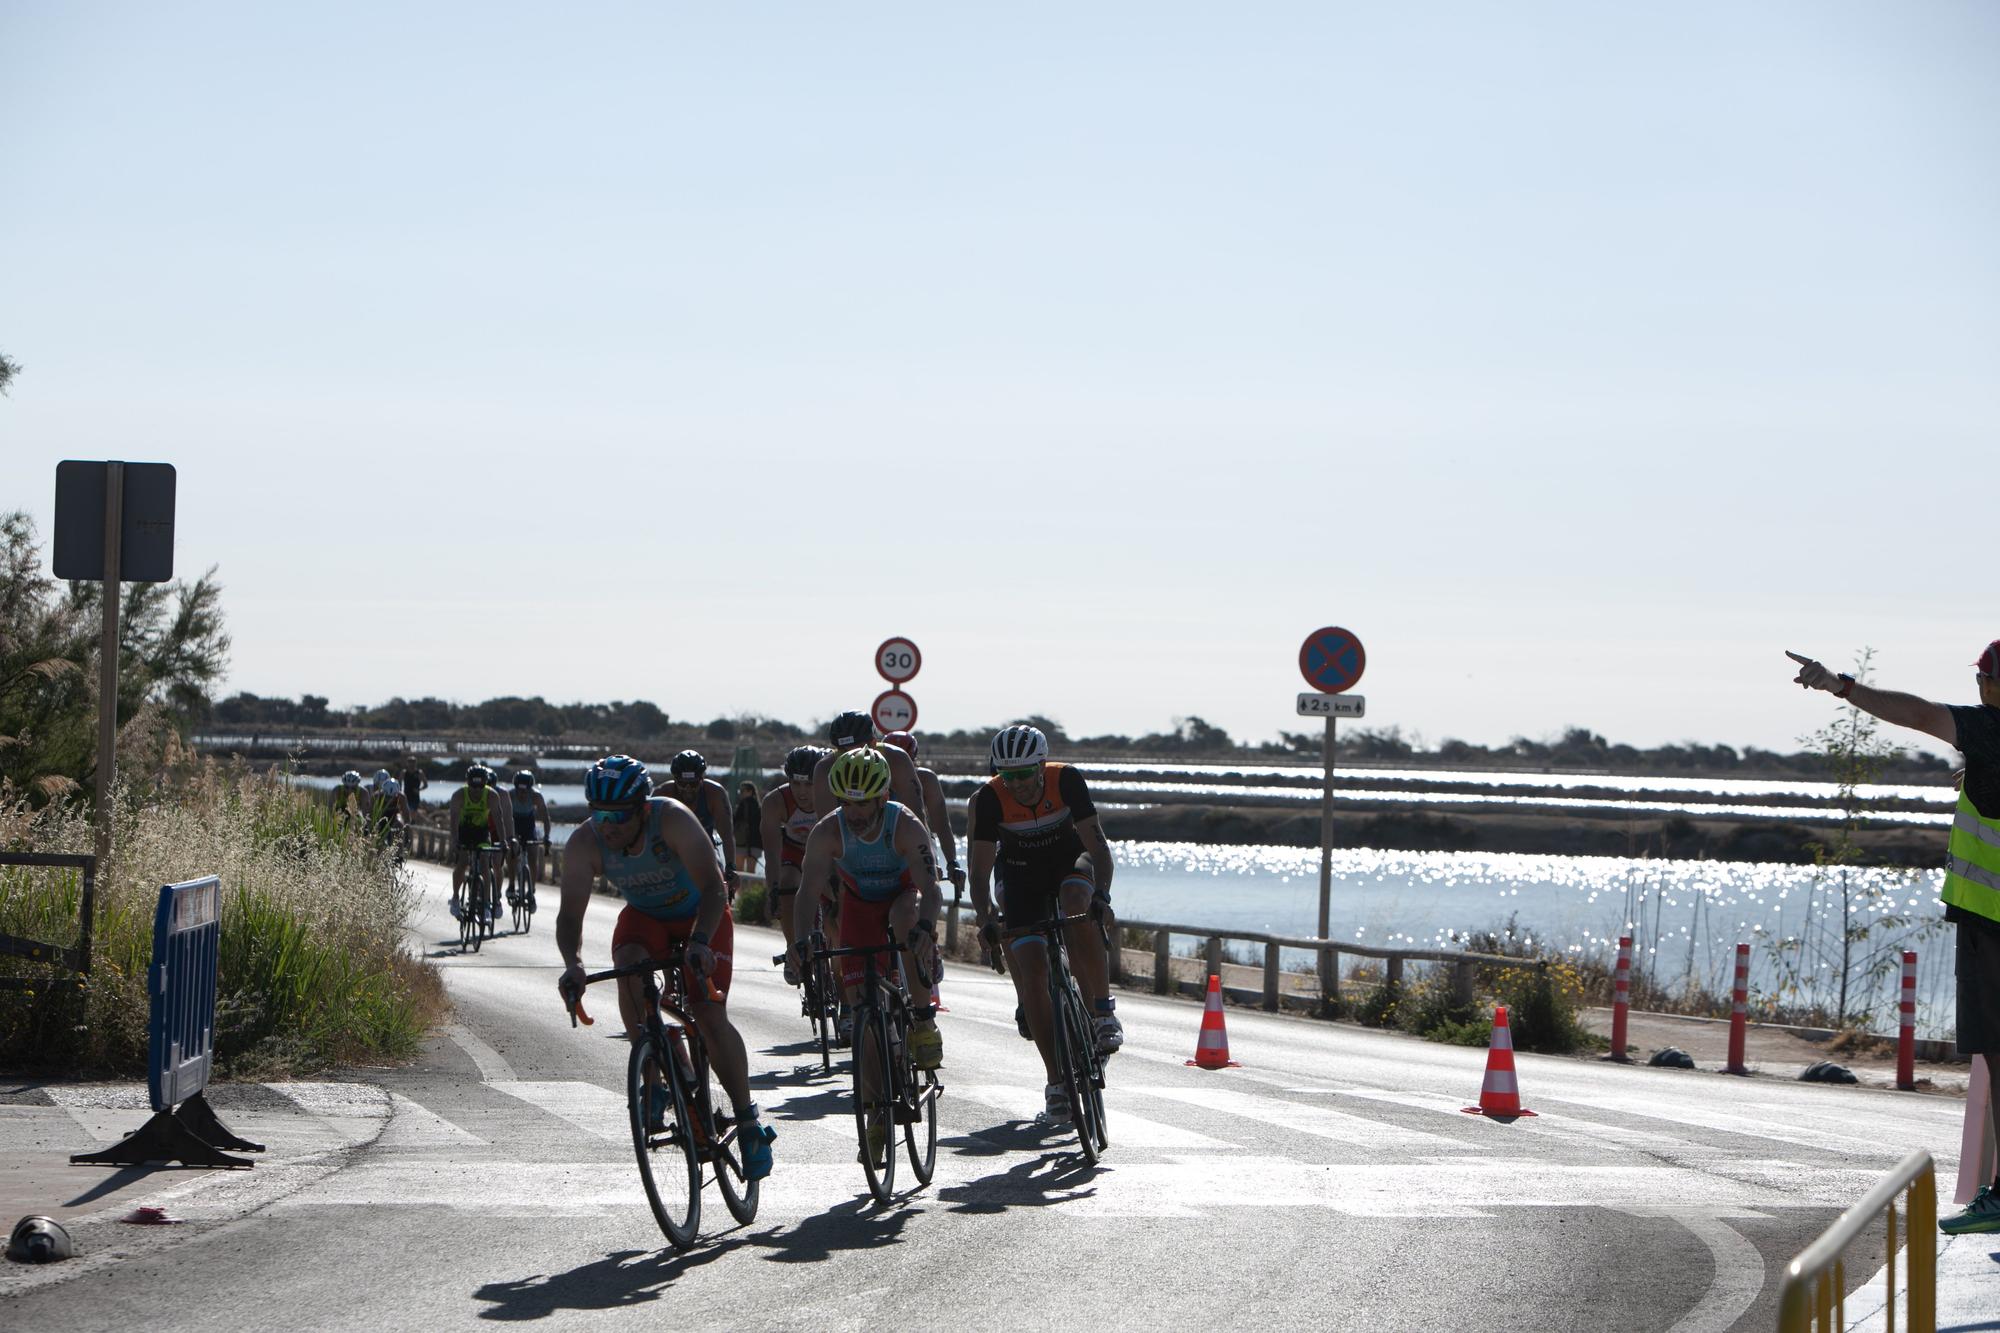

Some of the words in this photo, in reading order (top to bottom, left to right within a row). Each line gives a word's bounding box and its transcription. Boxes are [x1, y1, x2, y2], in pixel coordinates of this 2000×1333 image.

[885, 652, 912, 669] 30
[1311, 699, 1330, 712] 2,5
[1334, 702, 1352, 712] km
[616, 866, 675, 889] PARDO
